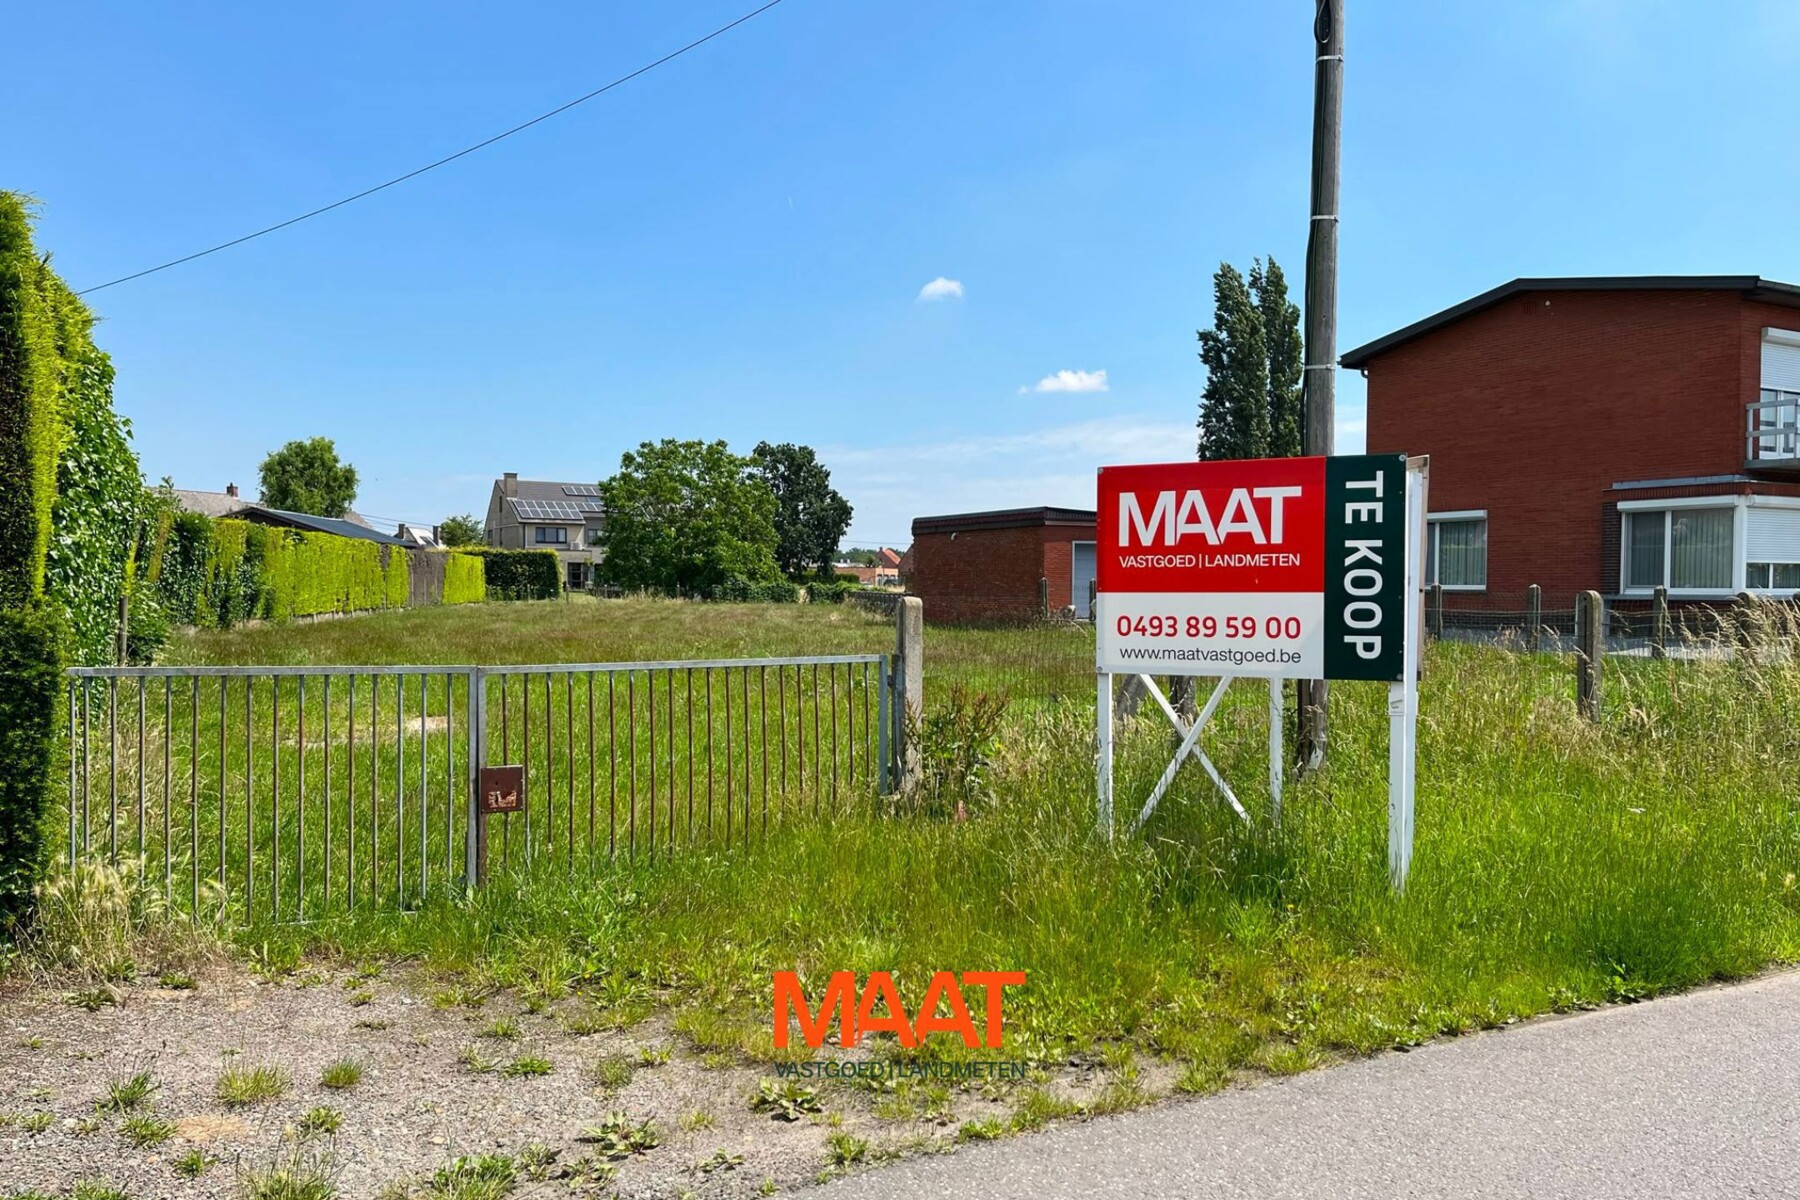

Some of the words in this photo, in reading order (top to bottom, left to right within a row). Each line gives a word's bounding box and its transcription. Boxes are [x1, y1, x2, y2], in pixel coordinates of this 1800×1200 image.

[1118, 486, 1302, 547] MAAT
[1345, 470, 1384, 524] TE
[1343, 539, 1383, 659] KOOP
[1117, 615, 1178, 637] 0493
[1186, 616, 1217, 638] 89
[1225, 616, 1256, 638] 59
[1265, 616, 1301, 639] 00
[1119, 647, 1301, 664] www.maatvastgoed.be
